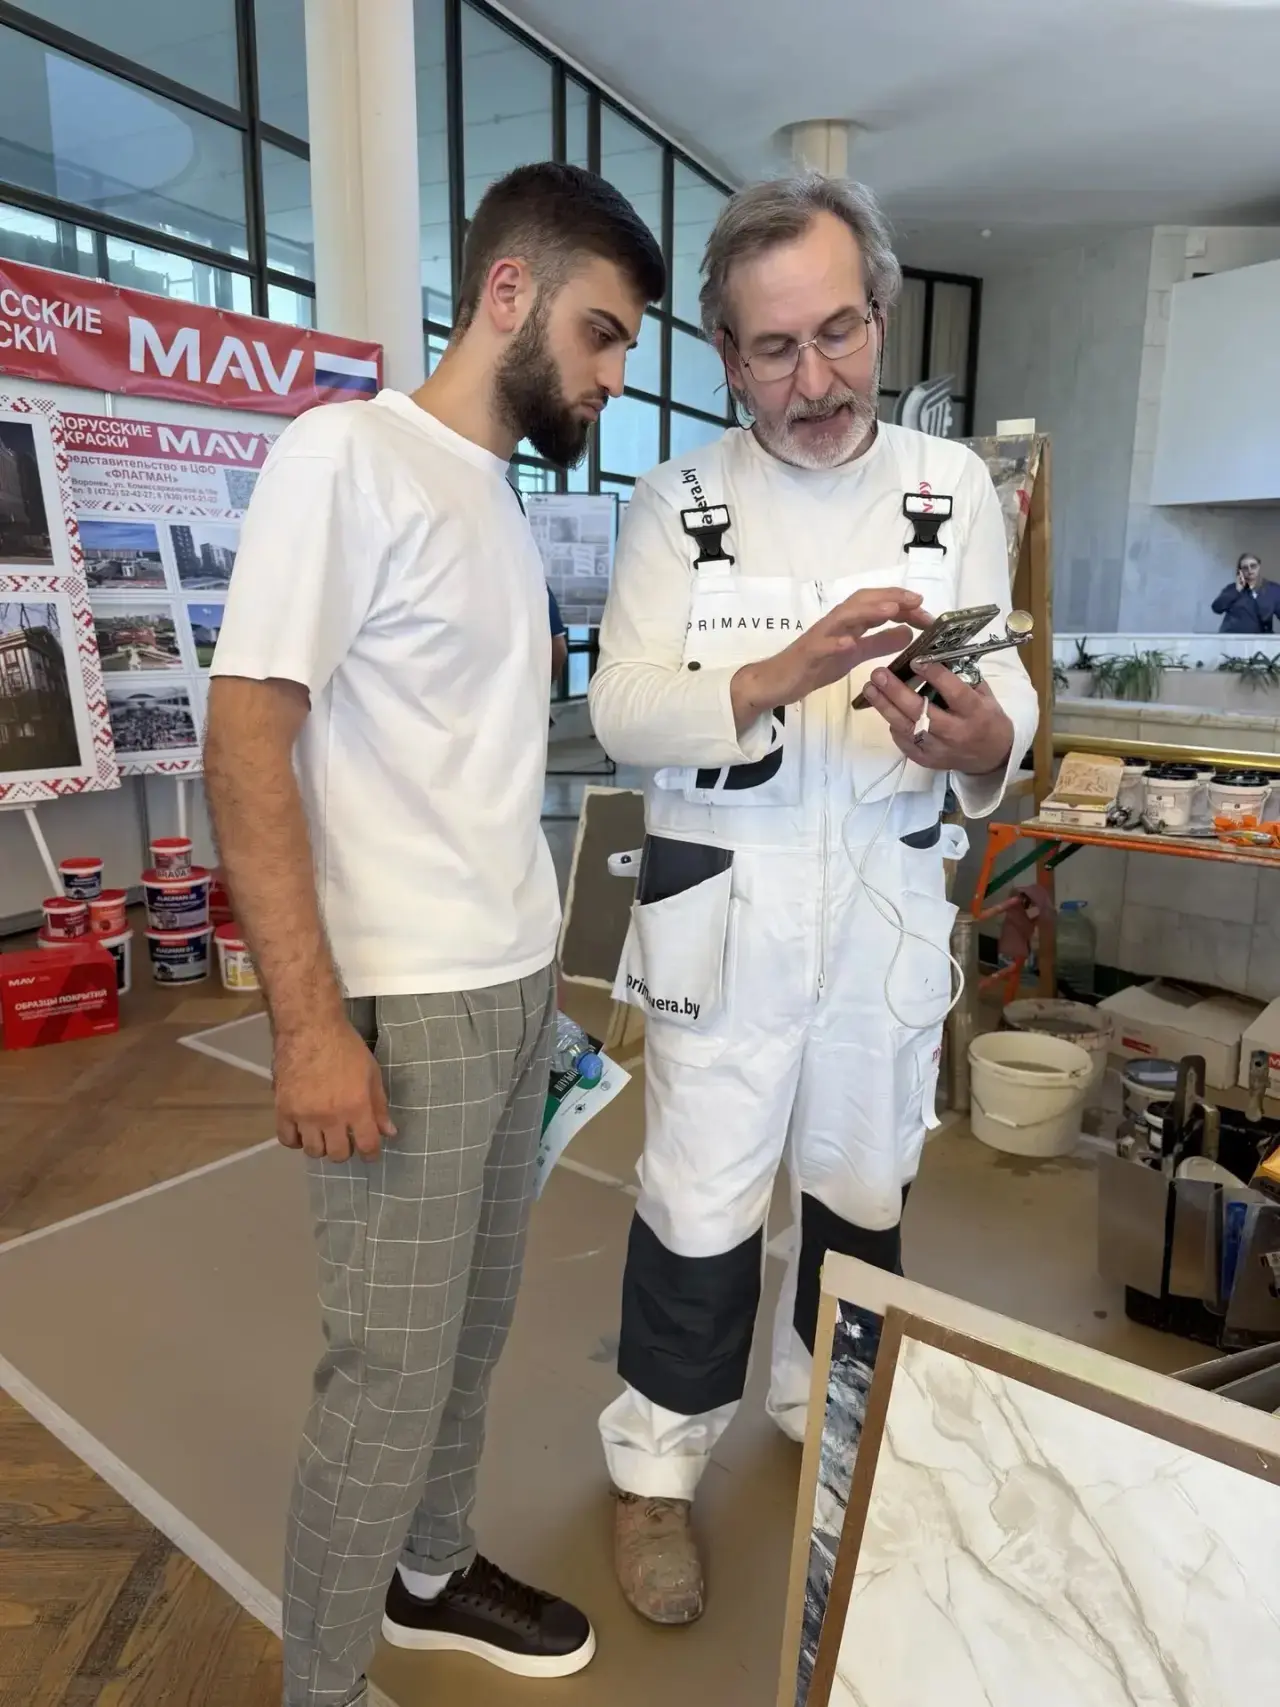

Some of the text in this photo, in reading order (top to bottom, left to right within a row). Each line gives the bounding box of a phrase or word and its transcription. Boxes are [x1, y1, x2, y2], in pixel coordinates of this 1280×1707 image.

[128, 315, 304, 396] MAV
[64, 430, 129, 448] КРАСКИ
[157, 426, 259, 461] MAV
[105, 469, 179, 482] «ФЛАГМАН»
[190, 464, 216, 475] ЦФО
